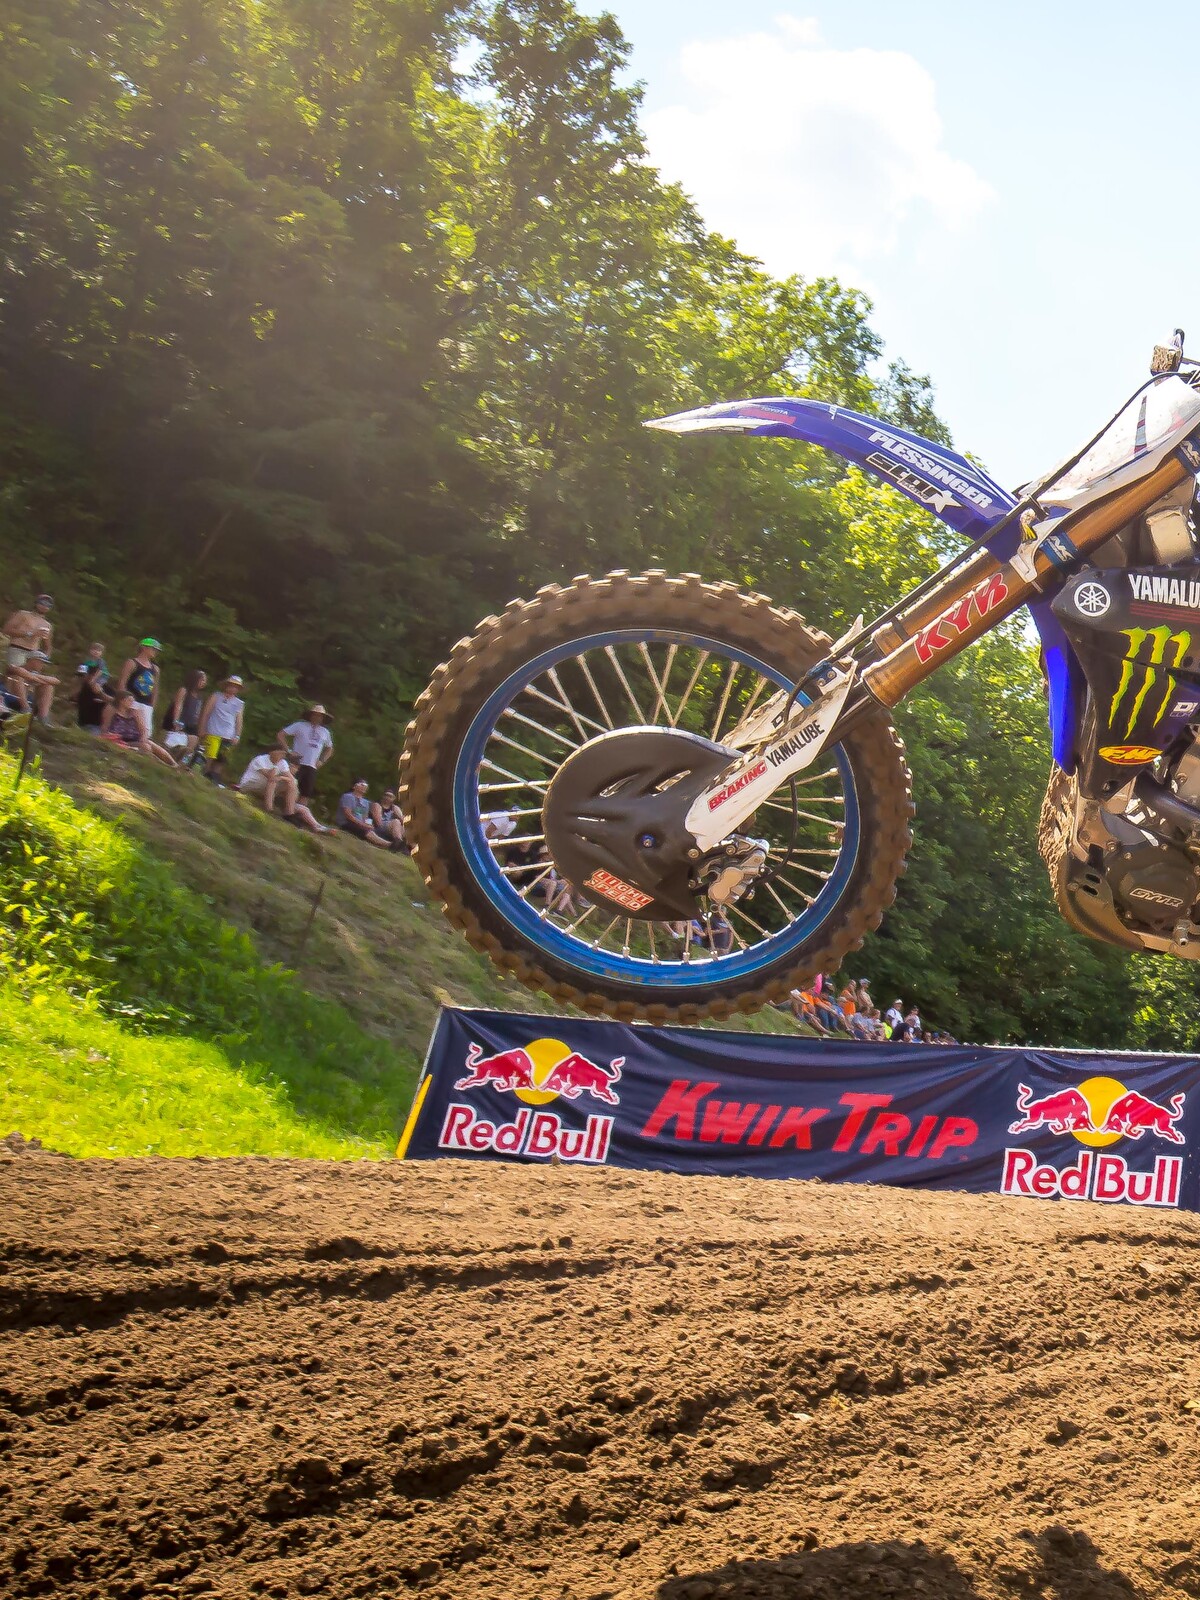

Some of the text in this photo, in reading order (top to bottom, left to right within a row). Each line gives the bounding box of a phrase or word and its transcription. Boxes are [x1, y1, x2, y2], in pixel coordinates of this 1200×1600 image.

[868, 431, 993, 509] PLESSINGER
[914, 573, 1008, 664] KYB
[766, 720, 825, 767] YAMALUBE
[707, 761, 768, 811] BRAKING
[584, 879, 641, 909] SPEED
[596, 871, 652, 903] LIGHT
[441, 1104, 614, 1162] Red Bull
[1002, 1149, 1182, 1206] Red Bull
